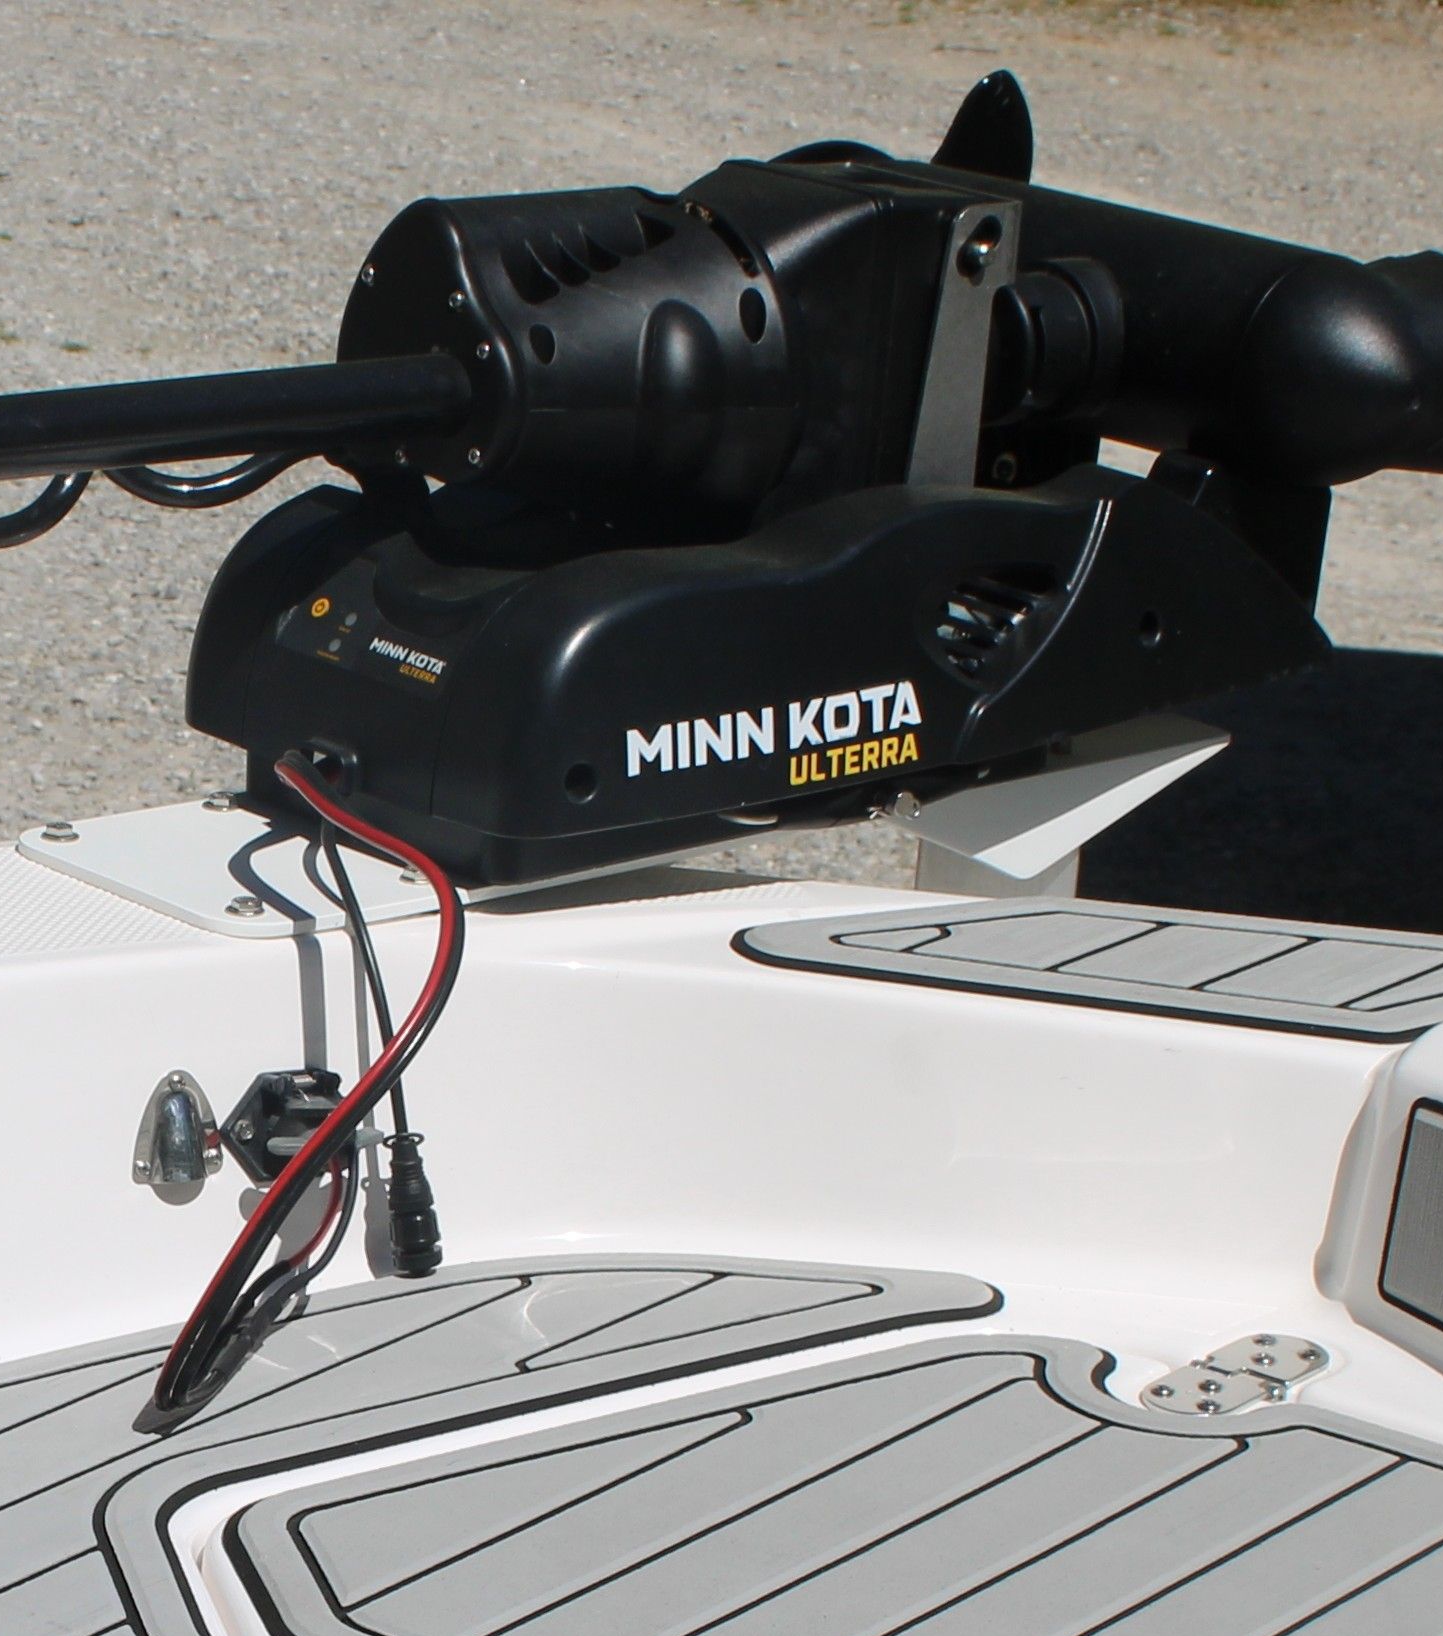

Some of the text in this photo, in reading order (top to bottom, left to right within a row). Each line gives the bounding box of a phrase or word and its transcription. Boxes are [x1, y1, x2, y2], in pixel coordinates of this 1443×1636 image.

[369, 637, 410, 661] MINN
[405, 649, 446, 675] KOTA
[398, 664, 438, 684] ULTERRA
[626, 680, 923, 778] MINN KOTA
[789, 733, 920, 786] ULTERRA
